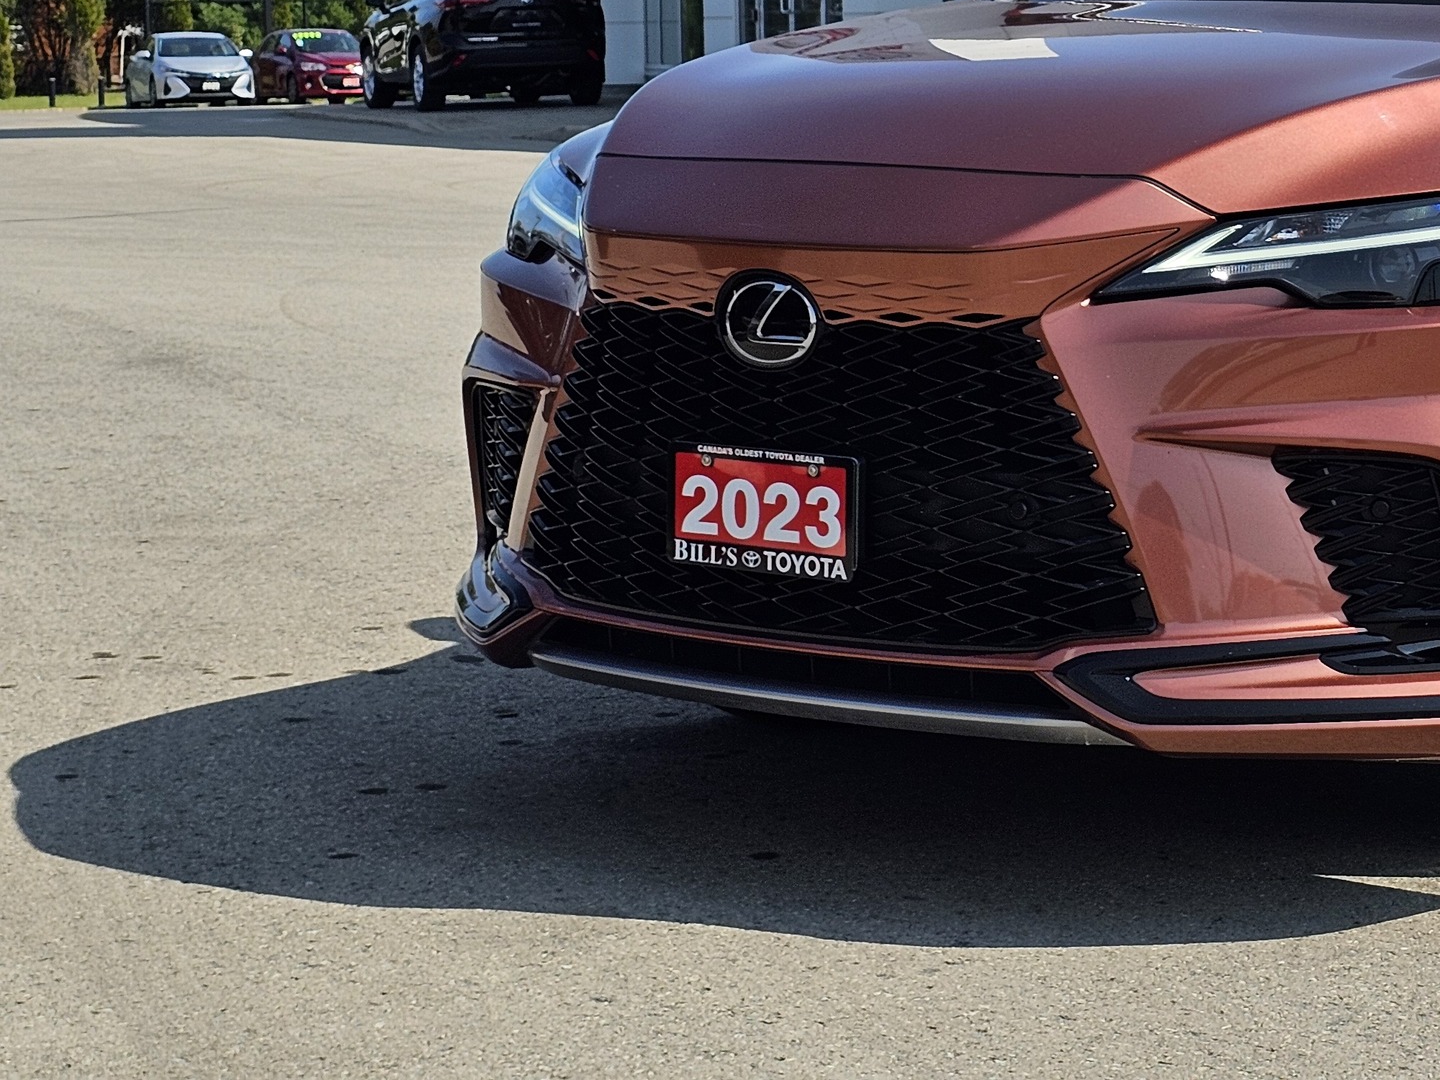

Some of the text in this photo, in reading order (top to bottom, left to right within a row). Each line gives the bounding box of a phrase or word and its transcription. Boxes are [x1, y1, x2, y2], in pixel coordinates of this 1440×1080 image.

[697, 444, 825, 465] CANADA'S OLDEST TOYOTA DEALER
[681, 474, 842, 549] 2023
[673, 538, 848, 580] BILL'S TOYOTA
